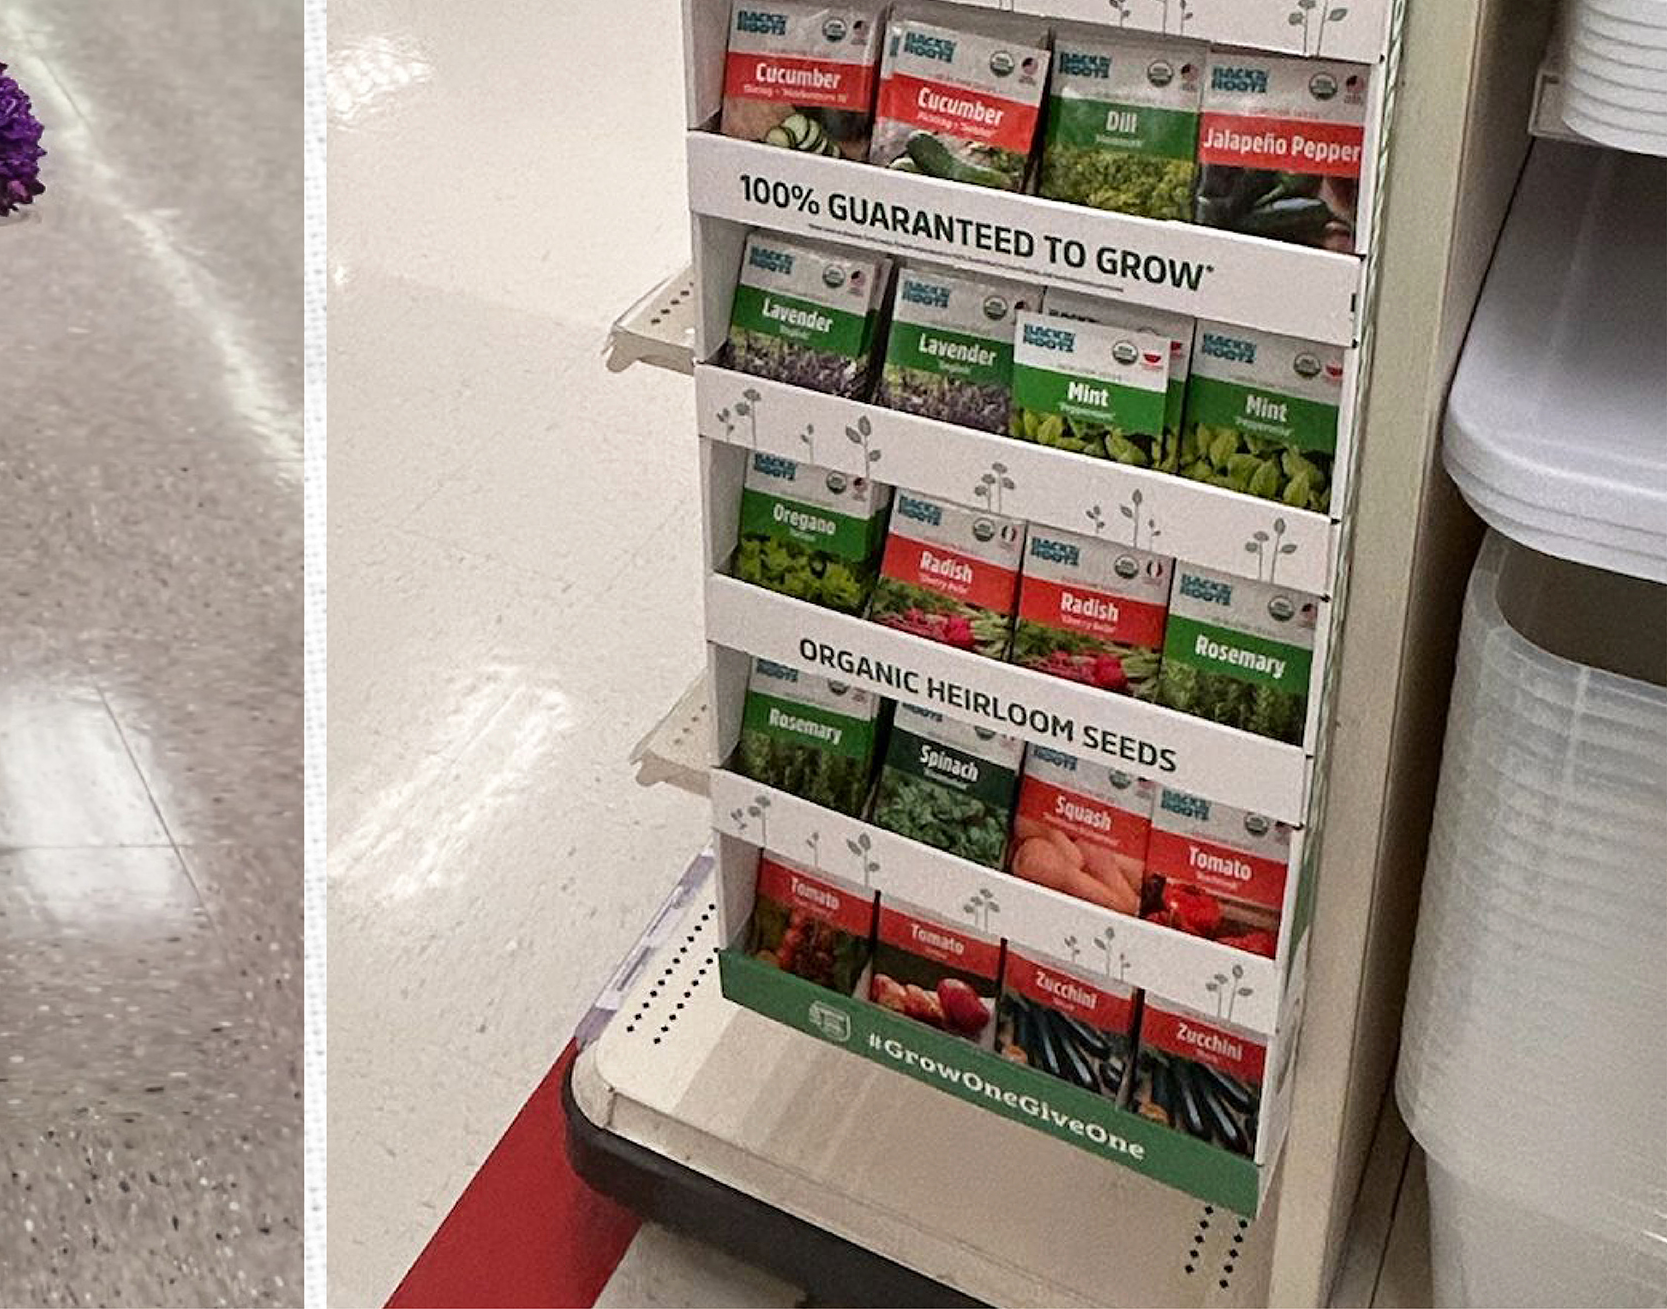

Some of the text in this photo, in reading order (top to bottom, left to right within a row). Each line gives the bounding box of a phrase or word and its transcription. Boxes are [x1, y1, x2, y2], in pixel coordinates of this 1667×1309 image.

[756, 63, 841, 89] Cucumber
[918, 86, 1004, 126] Cucumber
[1107, 111, 1138, 133] Dill
[1203, 128, 1361, 163] Jalapeño Pepper
[740, 174, 820, 215] 100%
[828, 194, 1035, 259] GUARANTEED
[1043, 235, 1086, 268] TO
[762, 297, 833, 334] Lavender
[919, 333, 997, 366] Lavender
[1067, 381, 1109, 408] Mint
[1245, 395, 1288, 423] Mint
[773, 503, 836, 536] Oregano
[920, 550, 972, 585] Radish
[1060, 592, 1119, 622] Radish
[1194, 634, 1286, 680] Rosemary
[799, 638, 1178, 773] ORGANIC HEIRLOOM SEEDS
[769, 708, 842, 746] Rosemary
[920, 744, 979, 783] Spinach
[1055, 795, 1112, 832] Squash
[1188, 846, 1253, 881] Tomato
[790, 877, 840, 910] Tomato
[910, 923, 965, 955] Tomato
[1035, 971, 1097, 1009] Zucchini
[1177, 1023, 1243, 1062] Zucchini
[869, 1032, 1146, 1161] #GrowOneGiveOne
